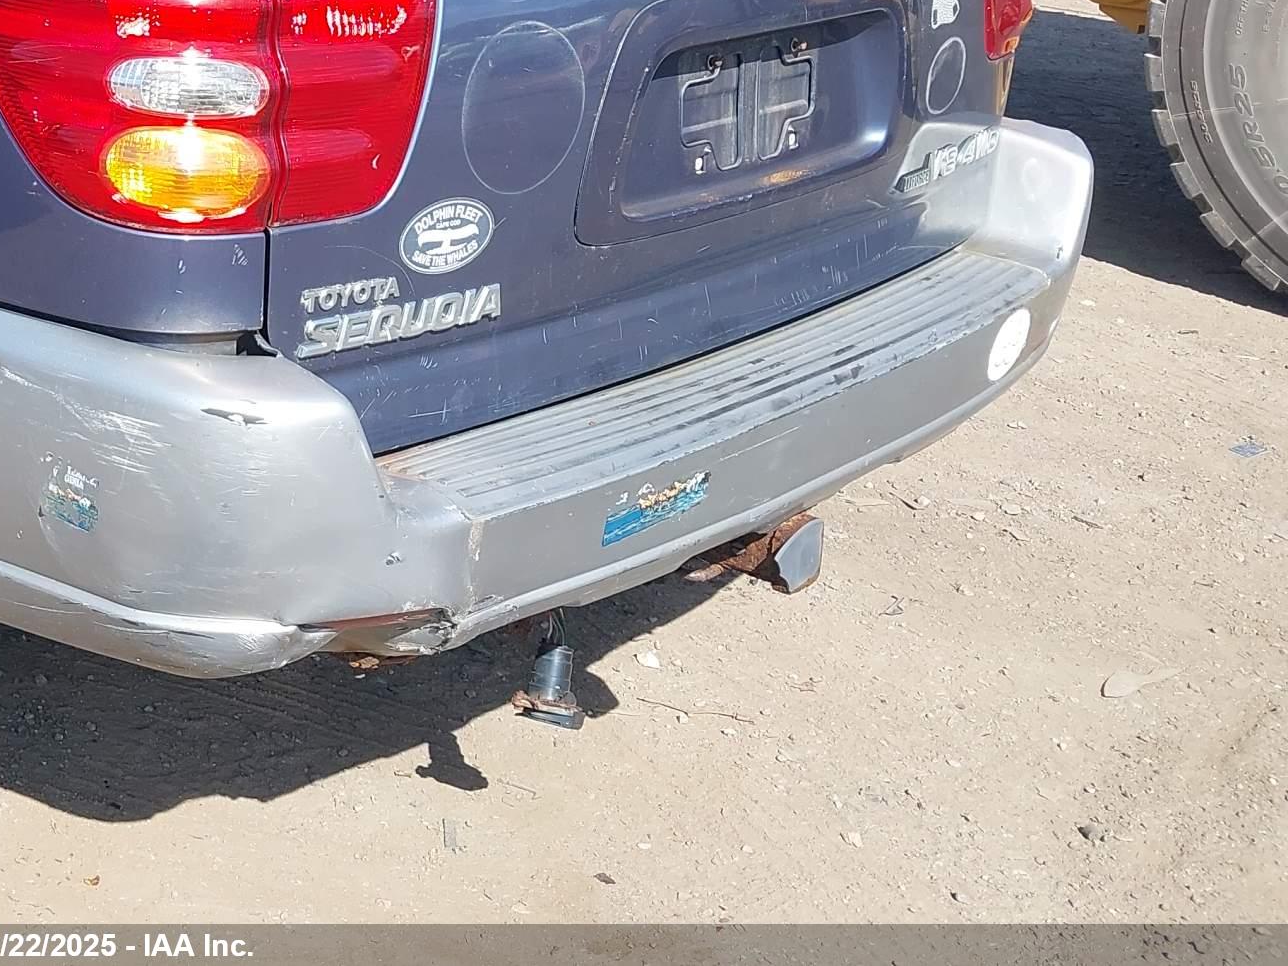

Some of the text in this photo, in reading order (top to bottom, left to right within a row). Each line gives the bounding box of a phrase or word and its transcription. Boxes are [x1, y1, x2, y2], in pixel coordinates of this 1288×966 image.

[414, 205, 483, 234] DOLPHIN FLEET
[412, 240, 479, 267] SAVE THE WHALES
[300, 277, 400, 313] TOYOTA
[295, 283, 502, 360] SEQUOIA
